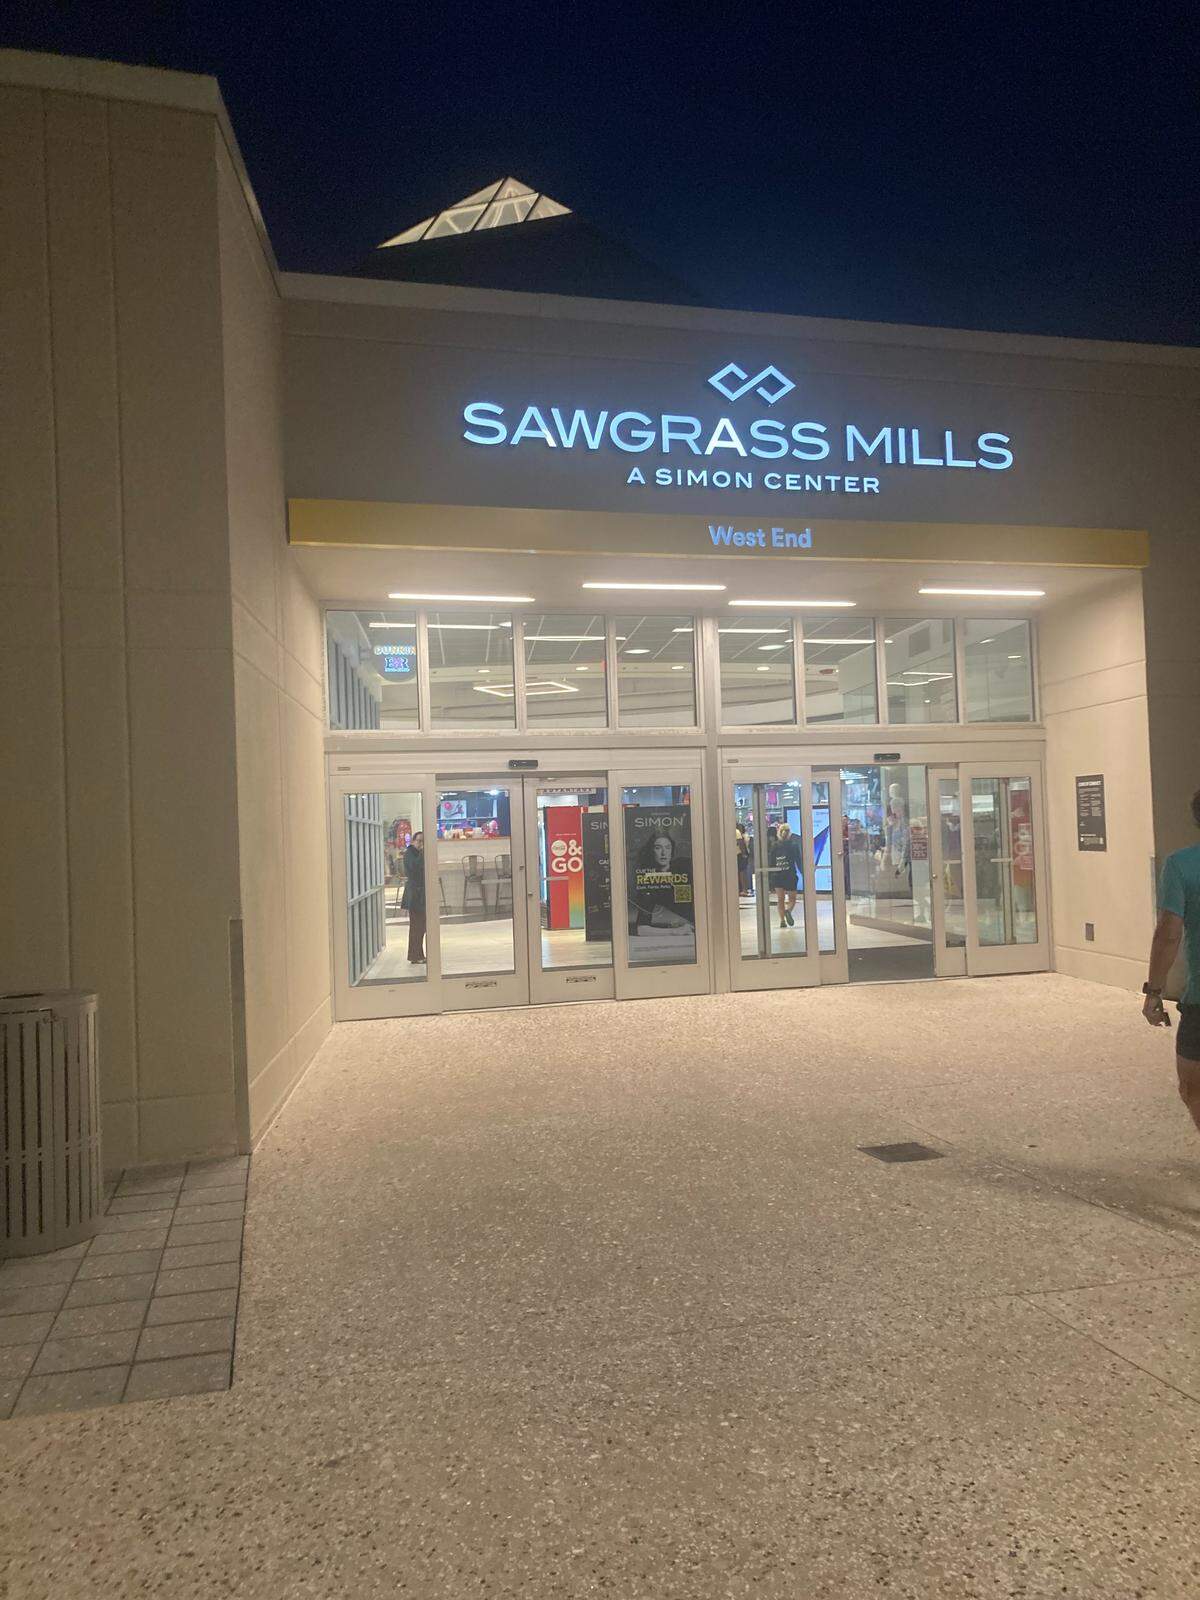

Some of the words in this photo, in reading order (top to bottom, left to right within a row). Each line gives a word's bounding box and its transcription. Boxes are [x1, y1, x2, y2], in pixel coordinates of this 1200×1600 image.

[463, 402, 830, 461] SAWGRASS
[846, 425, 1014, 470] MILLS
[626, 467, 647, 485] A
[655, 468, 753, 489] SIMON
[764, 473, 880, 493] CENTER
[708, 525, 766, 547] West
[771, 528, 812, 548] End
[634, 816, 684, 828] SIMON
[551, 857, 583, 874] GO
[636, 873, 689, 885] REWARDS
